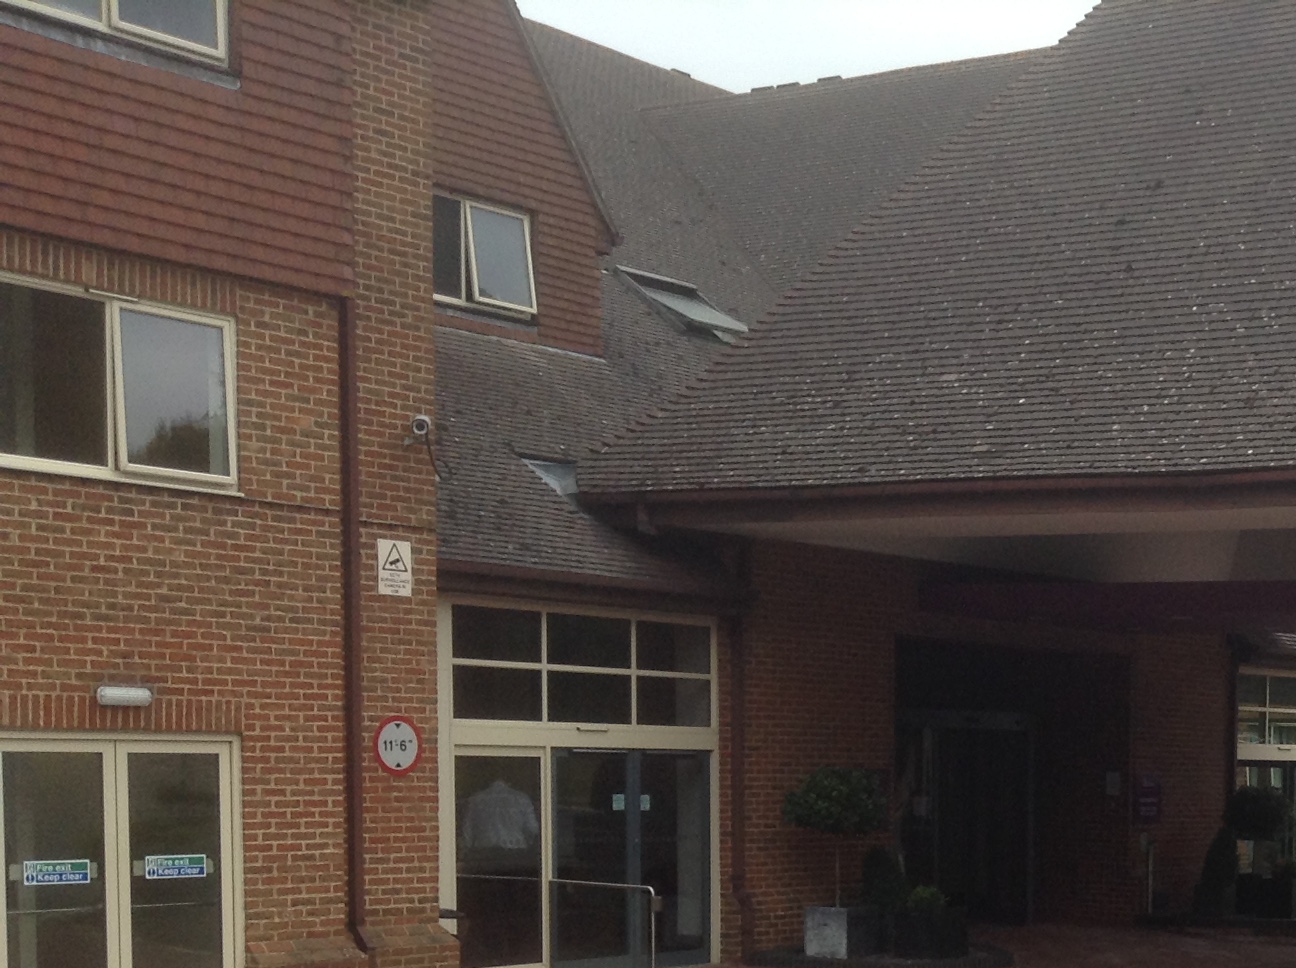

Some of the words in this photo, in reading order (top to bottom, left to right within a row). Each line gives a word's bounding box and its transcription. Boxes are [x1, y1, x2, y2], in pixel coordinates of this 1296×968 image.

[157, 858, 173, 866] Fire
[174, 857, 189, 866] exit
[36, 863, 54, 872] Fire
[55, 863, 72, 871] exit
[158, 868, 179, 877] Keep
[180, 867, 200, 875] clear
[37, 874, 60, 883] Keep
[62, 873, 83, 881] clear
